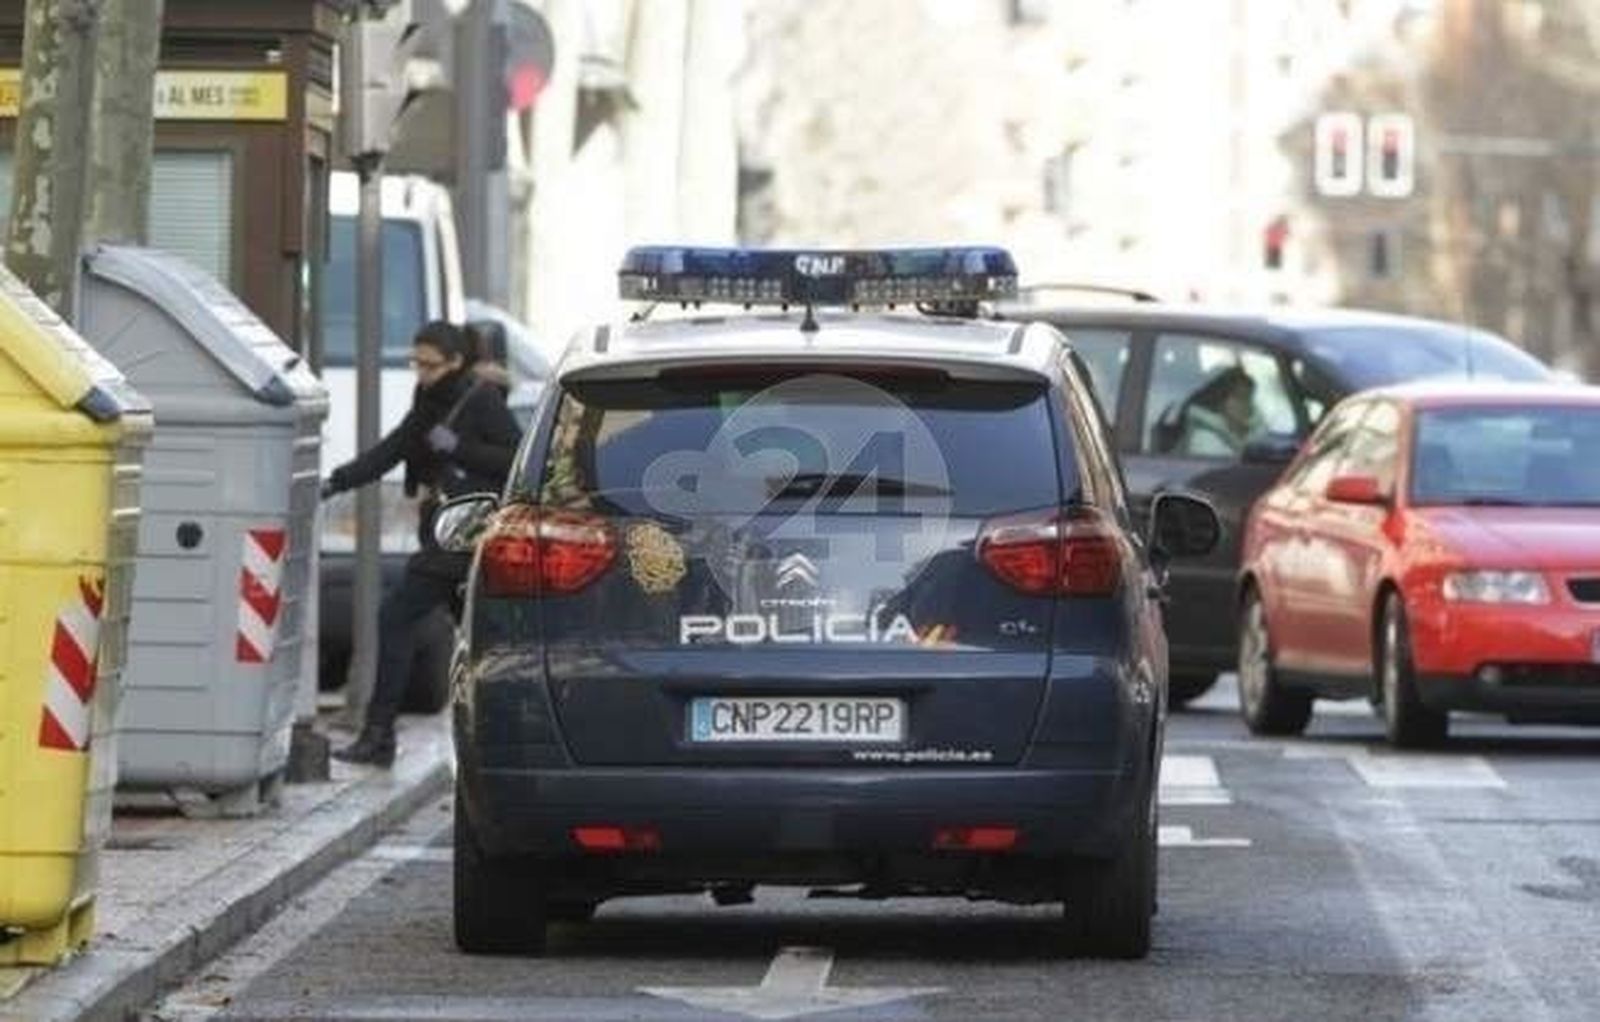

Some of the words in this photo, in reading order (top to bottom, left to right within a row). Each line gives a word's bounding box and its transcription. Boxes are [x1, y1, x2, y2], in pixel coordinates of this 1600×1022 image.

[190, 86, 224, 107] MES
[679, 603, 921, 644] POLICÍA
[711, 701, 895, 733] CNP2219RP
